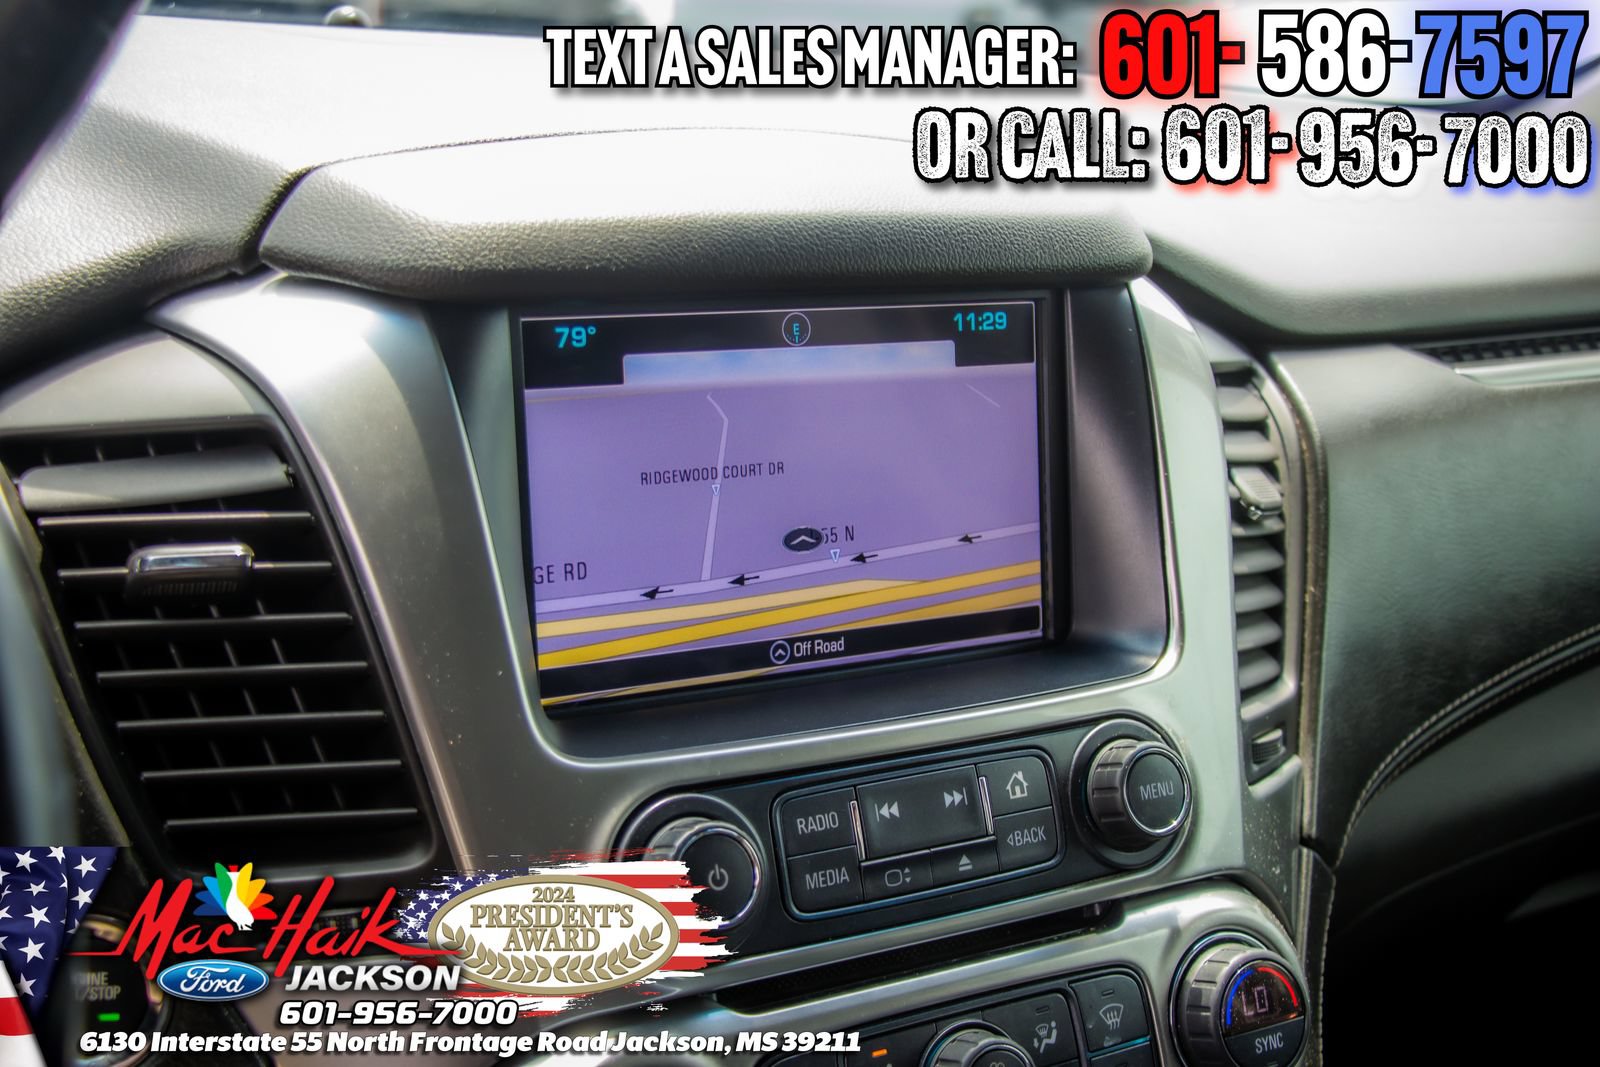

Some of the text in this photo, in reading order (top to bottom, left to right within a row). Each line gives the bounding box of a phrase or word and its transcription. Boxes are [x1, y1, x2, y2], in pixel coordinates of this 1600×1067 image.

[953, 311, 1007, 333] 11:29
[555, 325, 597, 349] 79°
[640, 461, 785, 486] RIDGEWOOD COURT DR
[845, 525, 855, 542] N
[564, 561, 588, 582] RD
[794, 636, 845, 657] Off Road
[1138, 779, 1175, 801] MENU
[796, 811, 840, 834] RADIO
[1013, 825, 1047, 846] BACK
[805, 866, 850, 890] MEDIA
[1255, 1031, 1284, 1054] SYNC
